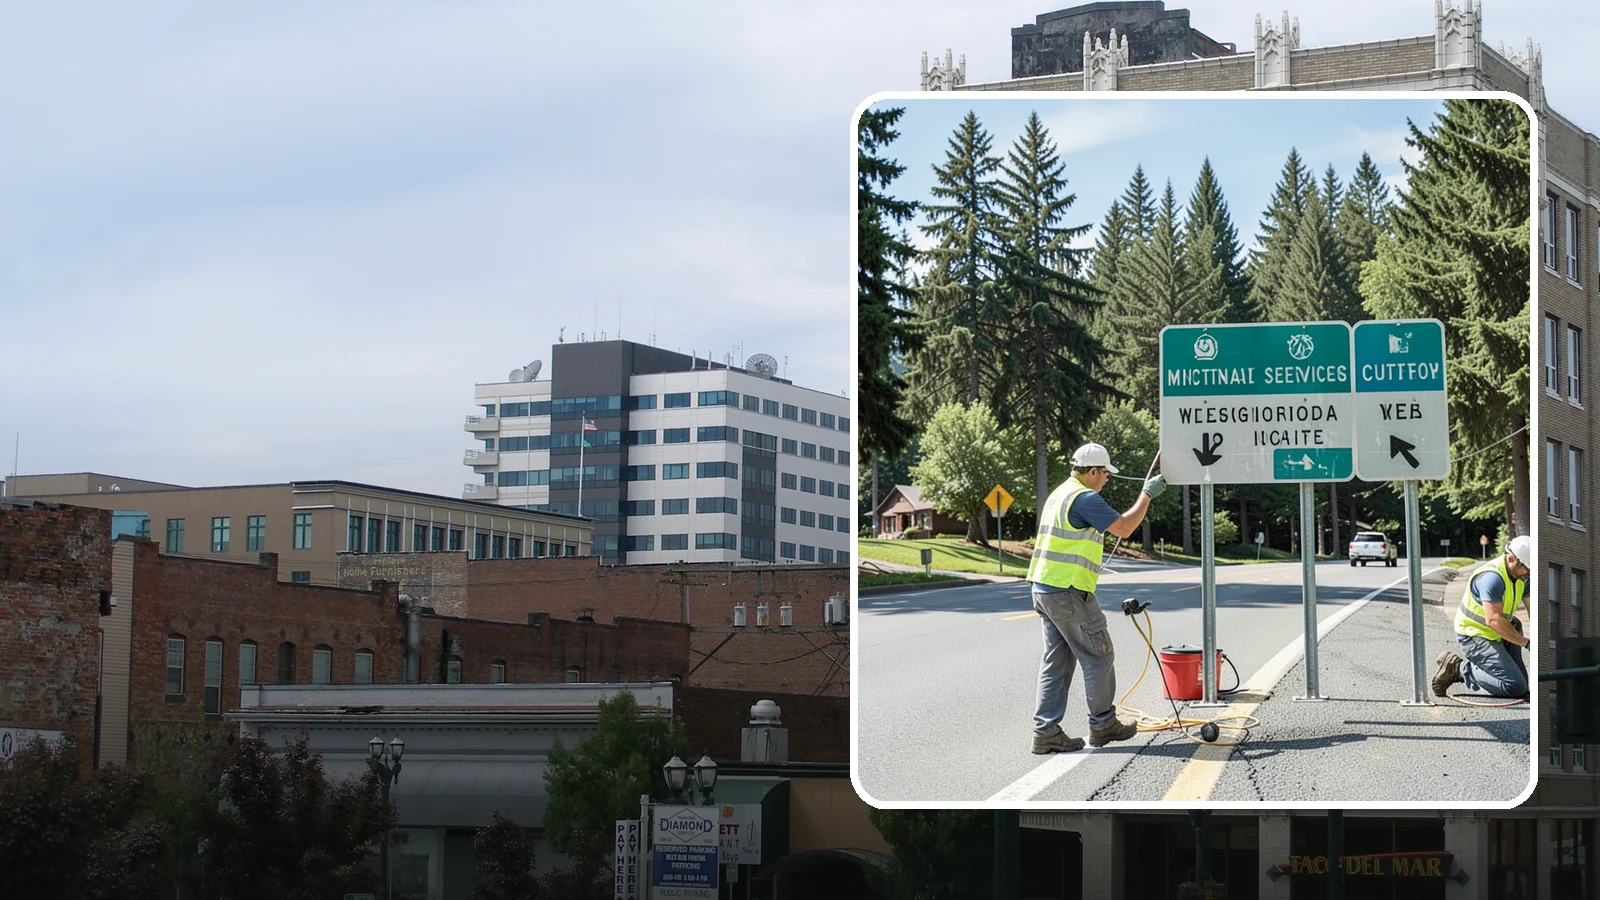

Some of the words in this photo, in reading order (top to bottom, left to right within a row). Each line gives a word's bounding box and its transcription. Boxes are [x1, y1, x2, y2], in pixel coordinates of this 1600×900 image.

[343, 568, 367, 577] Home
[370, 566, 427, 576] Furnishers
[660, 818, 713, 832] DIAMOND
[1022, 815, 1069, 827] BUILDING
[617, 825, 625, 852] PAY
[628, 824, 636, 852] PAY
[656, 845, 688, 853] RESERVED
[617, 856, 625, 893] HERE
[627, 856, 636, 893] HERE
[1345, 856, 1384, 875] DEL
[1392, 857, 1442, 877] MAR
[660, 889, 682, 897] PUBLIC
[683, 889, 710, 898] PARKING
